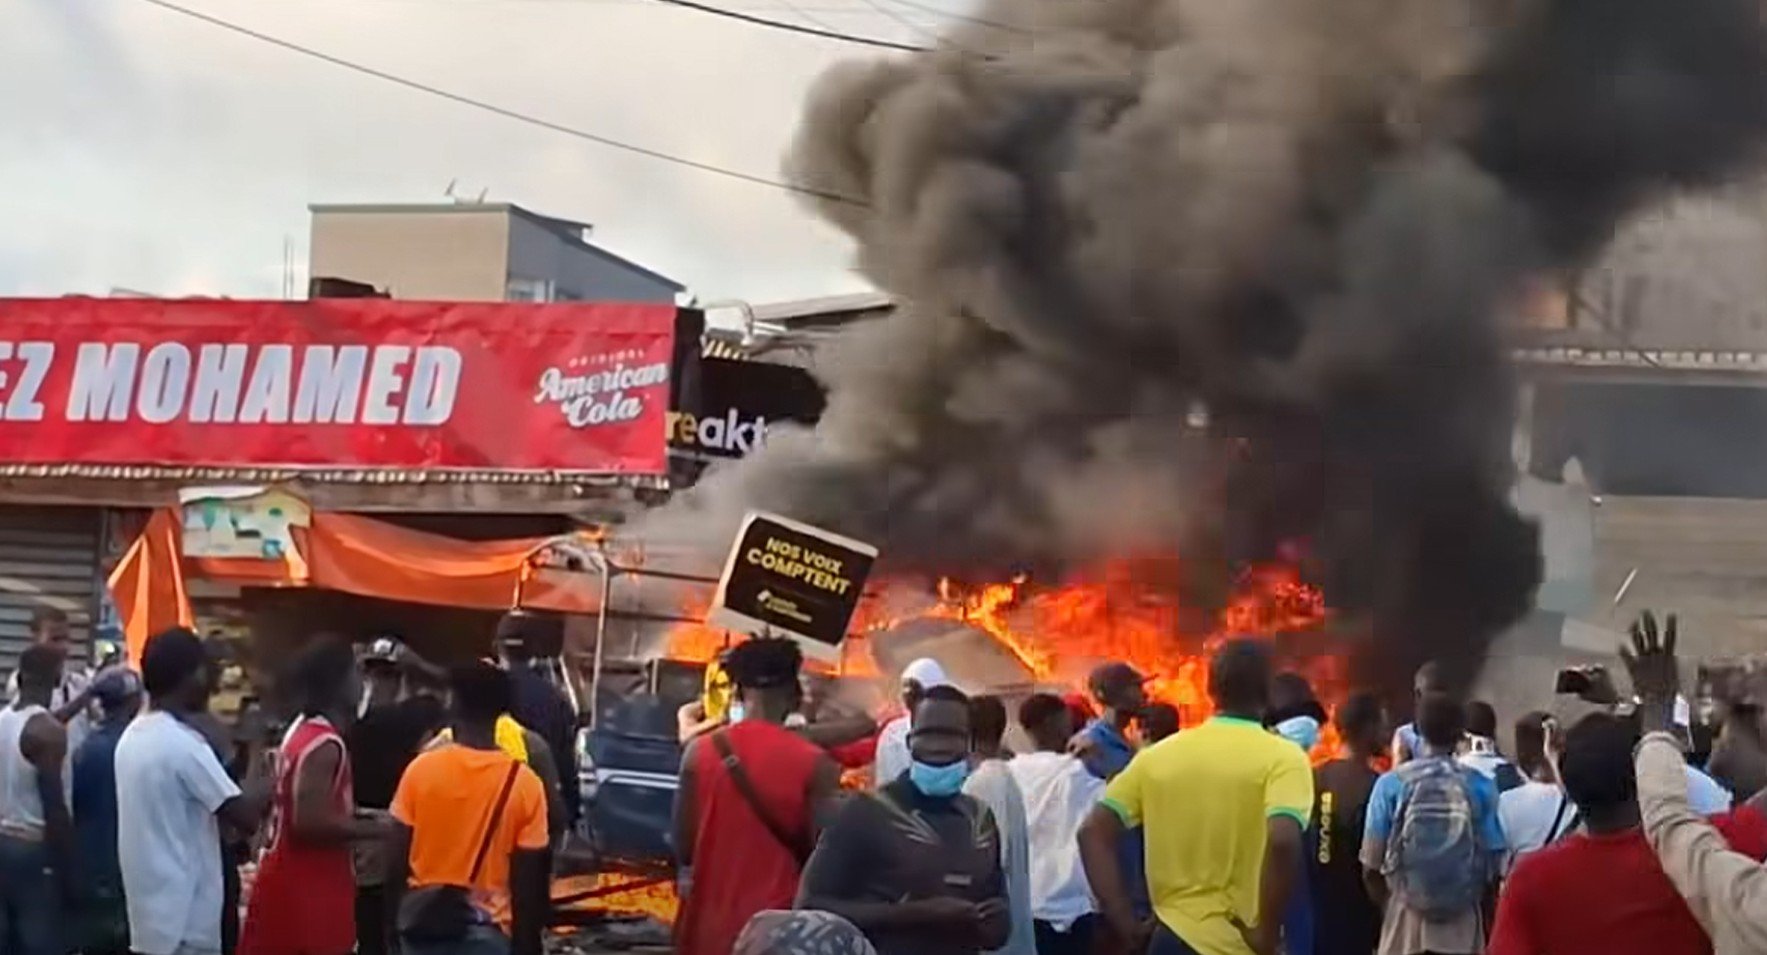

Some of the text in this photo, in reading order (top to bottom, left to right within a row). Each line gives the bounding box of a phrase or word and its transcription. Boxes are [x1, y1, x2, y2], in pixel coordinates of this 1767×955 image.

[66, 342, 462, 426] MOHAMED
[534, 363, 668, 403] American
[561, 391, 642, 427] Cola
[747, 547, 851, 595] COMPTENT
[766, 536, 843, 575] NOS VOIX
